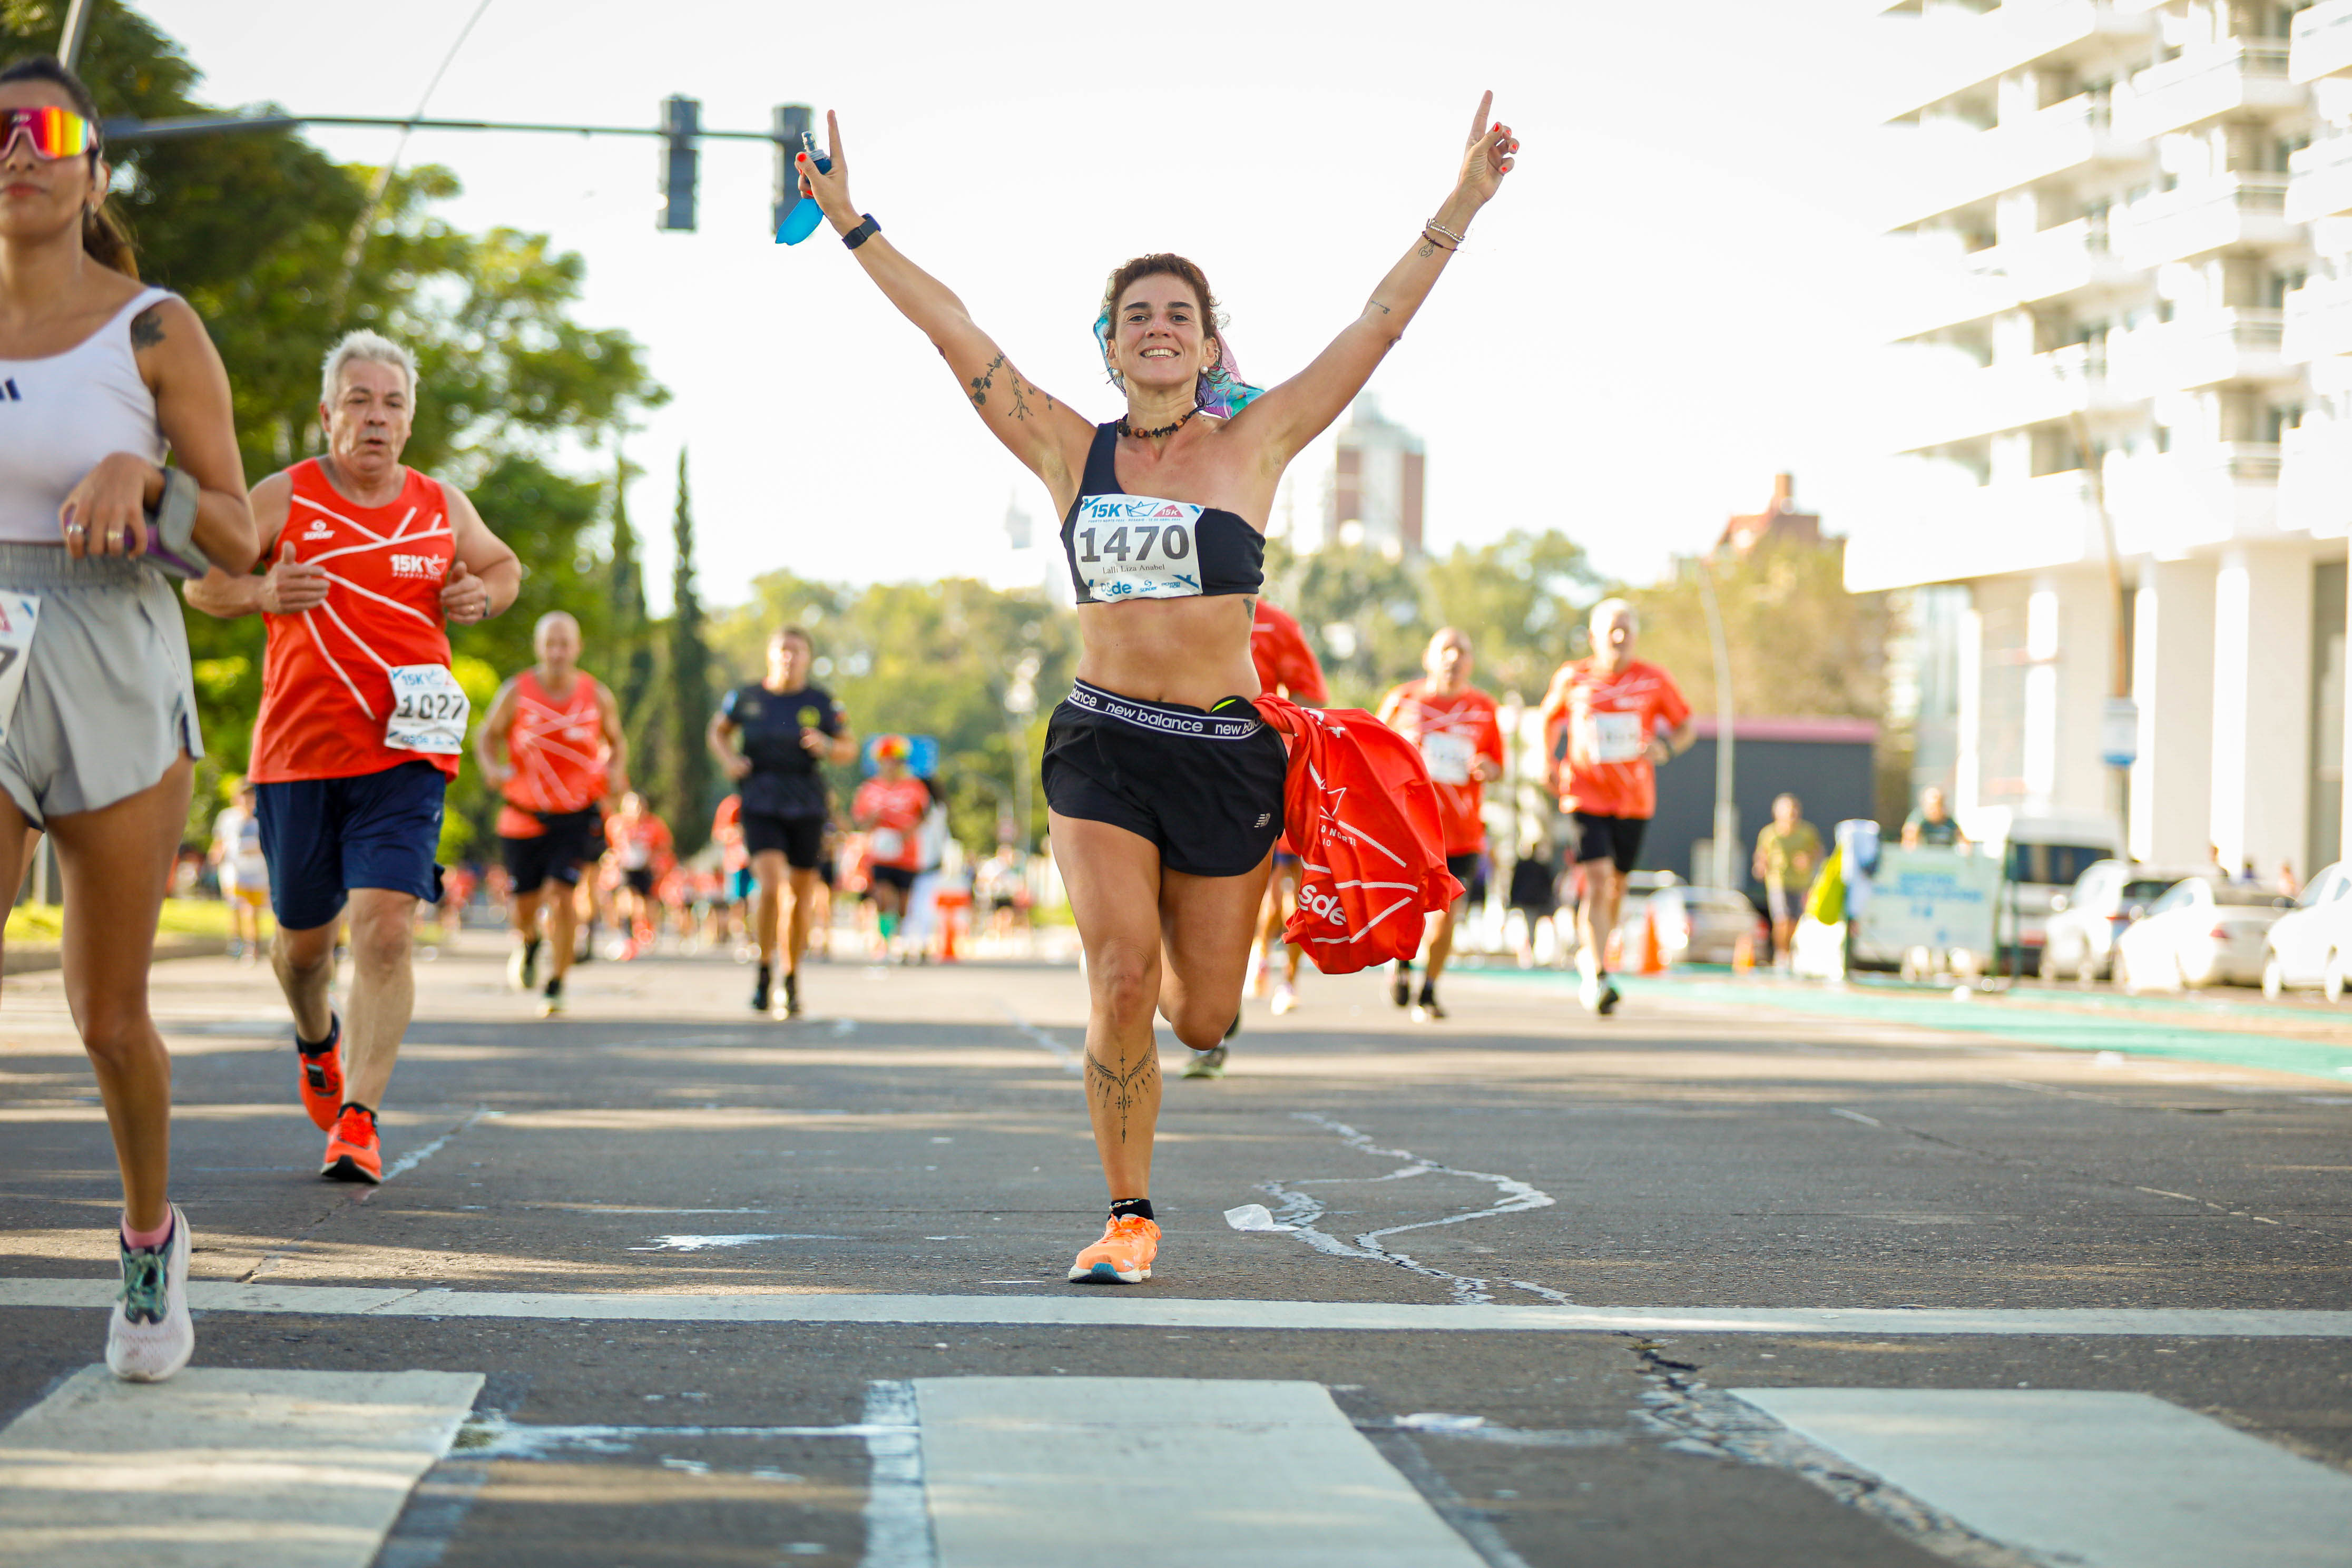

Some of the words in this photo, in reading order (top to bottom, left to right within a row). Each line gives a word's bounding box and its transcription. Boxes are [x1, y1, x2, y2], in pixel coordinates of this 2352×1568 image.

[1091, 503, 1123, 518] 15K
[1080, 525, 1189, 562] 1470
[390, 554, 424, 573] 15K
[401, 674, 424, 685] 15K
[397, 692, 464, 720] 1027
[1105, 702, 1136, 718] new
[1136, 709, 1203, 732] balance
[1215, 722, 1242, 735] new
